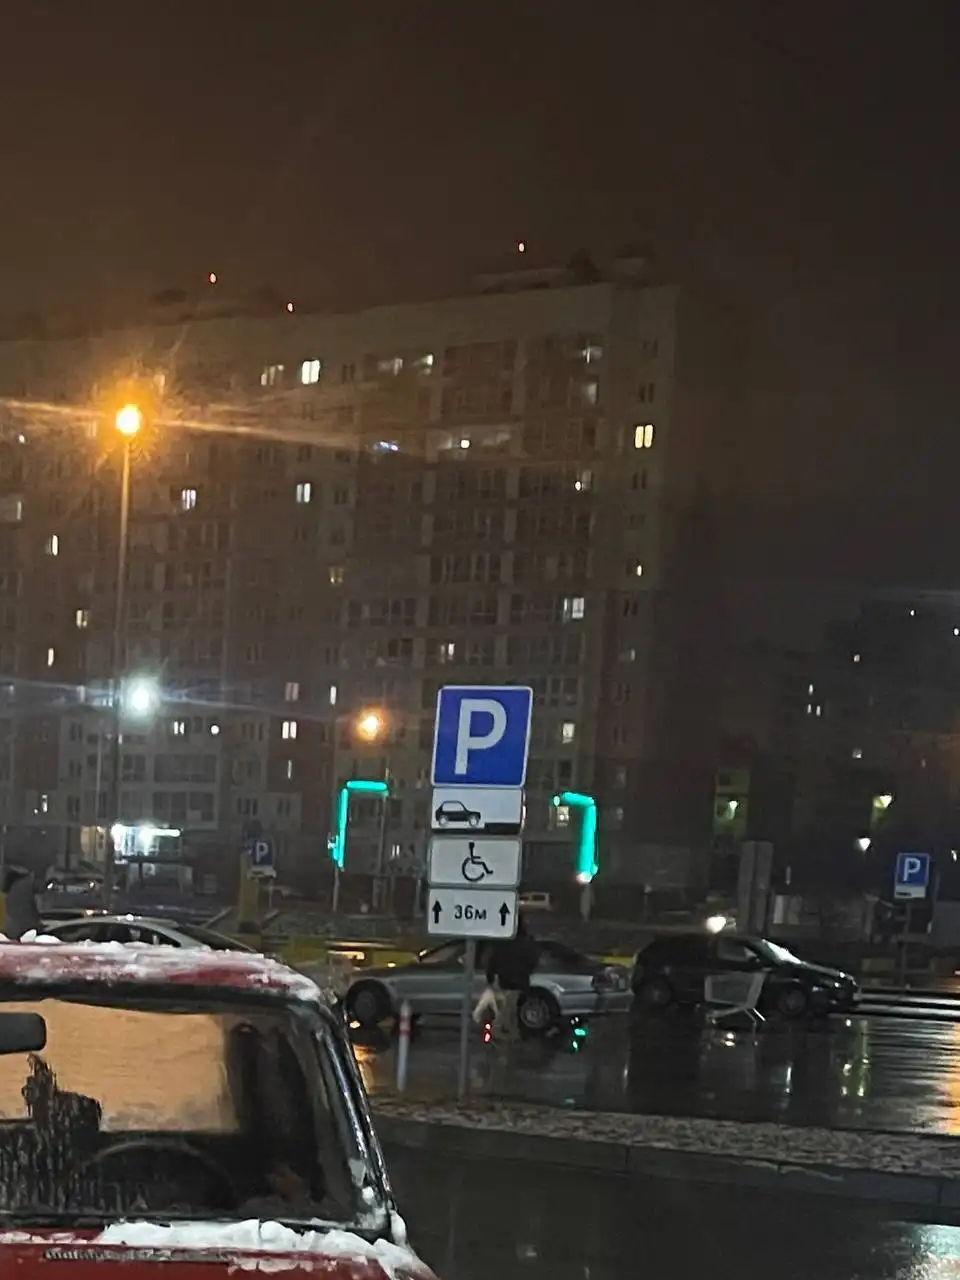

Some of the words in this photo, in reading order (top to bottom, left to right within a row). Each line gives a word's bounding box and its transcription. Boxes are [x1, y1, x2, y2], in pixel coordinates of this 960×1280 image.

[454, 698, 507, 776] P
[255, 841, 269, 863] P
[903, 857, 921, 882] P
[454, 904, 487, 921] 36м
